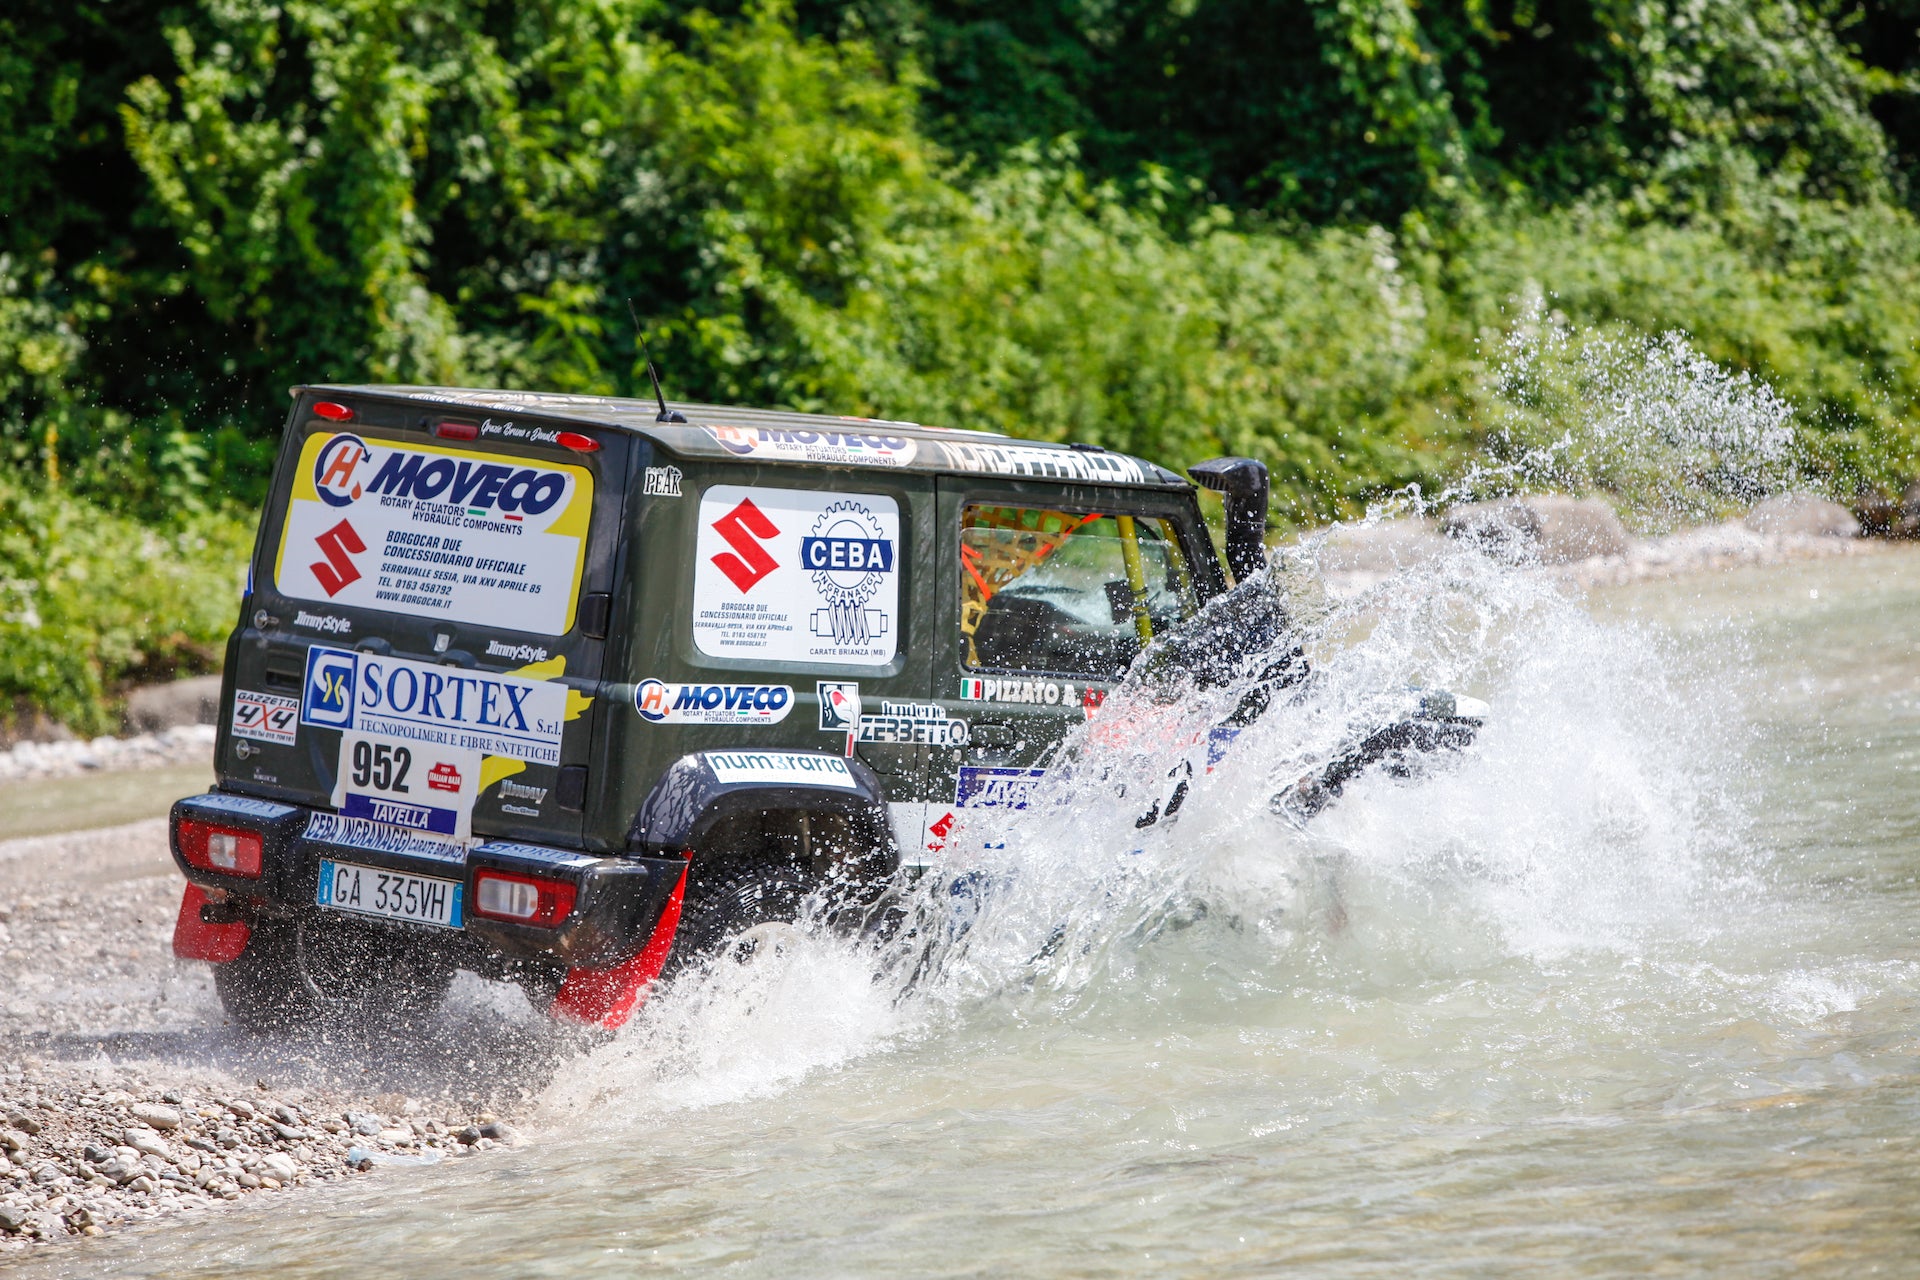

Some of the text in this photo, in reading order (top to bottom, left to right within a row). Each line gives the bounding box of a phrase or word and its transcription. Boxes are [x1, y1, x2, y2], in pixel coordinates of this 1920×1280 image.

[806, 451, 897, 466] HYDRAULIC COMPONENTS
[365, 452, 566, 515] MOVECO
[643, 466, 682, 495] PEAK
[380, 496, 465, 517] ROTARY ACTUATORS
[412, 511, 523, 535] HYDRAULIC COMPONENTS
[386, 530, 463, 552] BORGOCAR DUE
[809, 540, 884, 568] CEBA
[383, 545, 527, 575] CONCESSIONARIO UFFICIALE
[378, 576, 452, 596] TEL. 0163 458792
[381, 562, 542, 594] SERRAVALLE SESIA, VIA XXV APRILE 85
[819, 571, 875, 598] INGRANAGGI
[375, 590, 453, 609] WWW.BORGOCAR.IT
[721, 602, 768, 612] BORGOCAR DUE
[700, 610, 788, 621] CONCESSIONARIO UFFICIALE
[809, 648, 886, 657] CARATE BRIANZA (MB)
[237, 691, 298, 709] GAZZETTA
[361, 662, 534, 732] SORTEX
[536, 718, 562, 736] S.r.l.
[672, 686, 788, 710] MOVECO
[983, 679, 1060, 705] PIZZATO
[359, 718, 447, 745] TECNOPOLIMERI
[450, 733, 457, 746] E
[460, 735, 493, 751] FIBRE
[352, 740, 412, 793] 952
[369, 799, 432, 829] TAVELLA
[306, 813, 339, 839] CEBA
[338, 817, 412, 852] INGRANAGGI
[408, 838, 436, 855] CARATE
[335, 867, 361, 907] GA
[375, 873, 446, 920] 335VH
